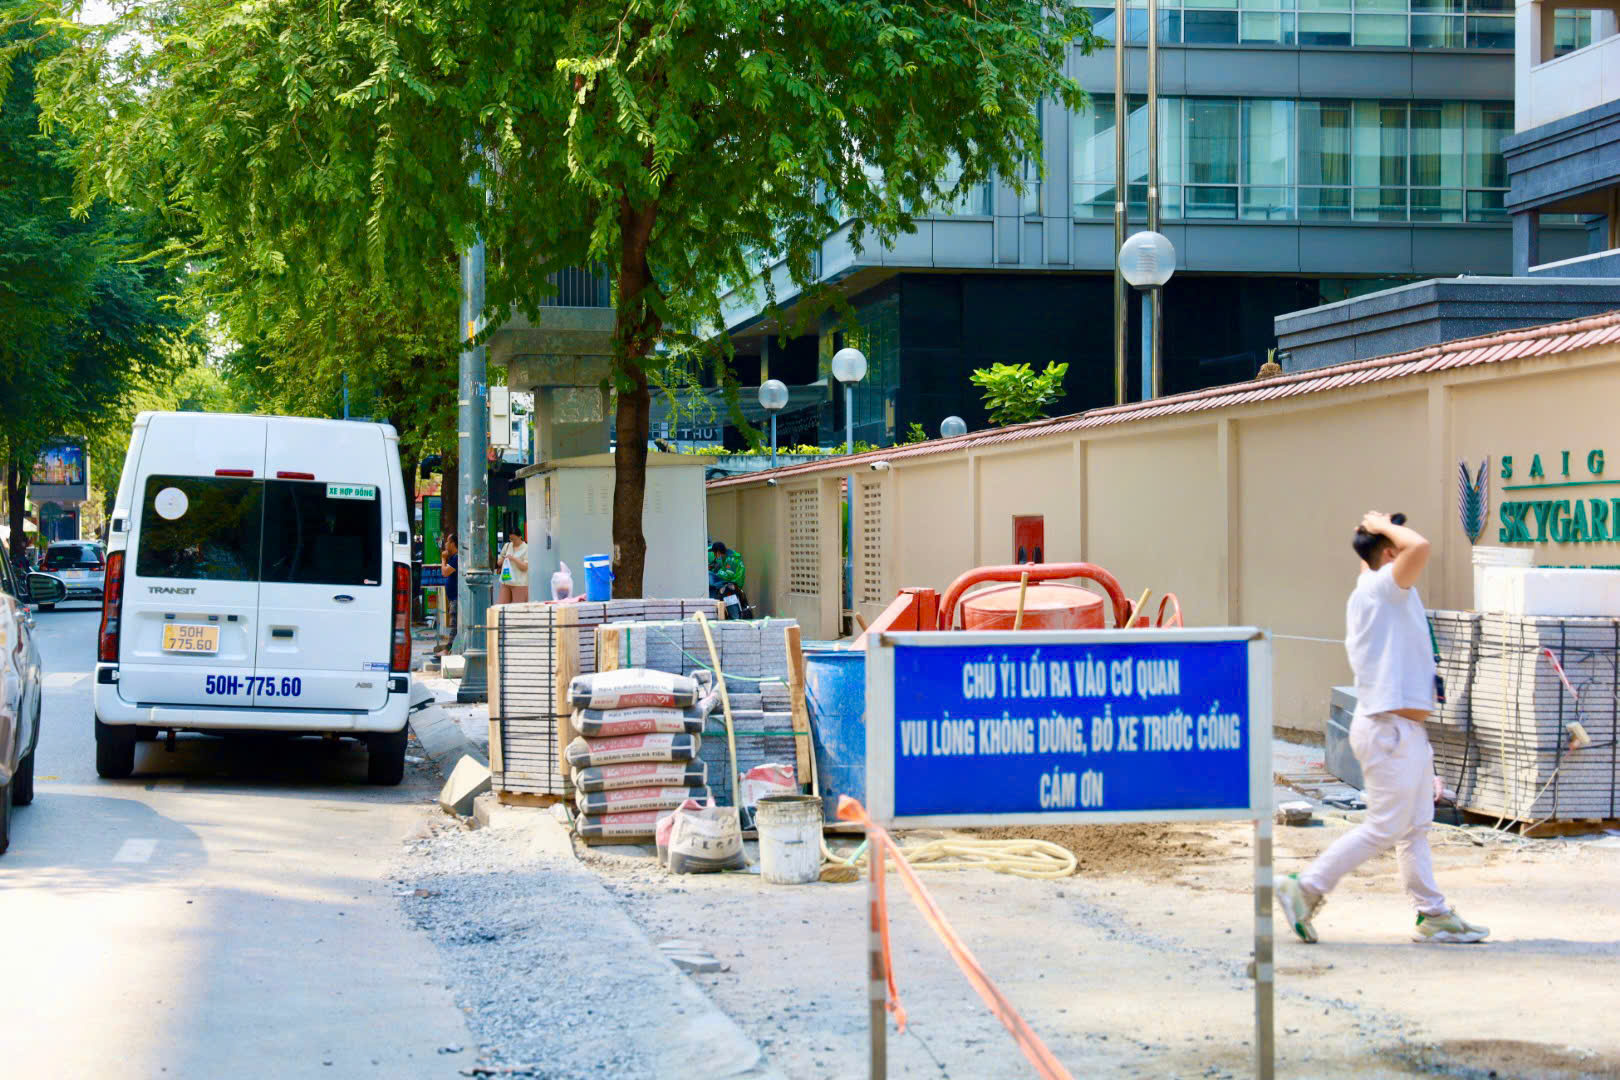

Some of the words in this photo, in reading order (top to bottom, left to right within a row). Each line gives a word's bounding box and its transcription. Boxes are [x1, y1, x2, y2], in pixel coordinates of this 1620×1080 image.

[329, 487, 338, 496] XE
[148, 586, 197, 595] TRANSIT
[179, 626, 205, 638] 50H
[169, 638, 213, 651] 775.60
[962, 653, 996, 699] CHÚ
[1020, 647, 1047, 698] LỐI
[1049, 660, 1072, 698] RA
[1074, 652, 1107, 698] VÀO
[1110, 656, 1133, 697] CƠ
[1136, 658, 1181, 701] QUAN
[205, 674, 302, 697] 50H-775.60
[900, 719, 928, 757] VUI
[931, 709, 975, 756] LÒNG
[978, 710, 1035, 756] KHÔNG
[1038, 709, 1088, 757] DỪNG,
[1116, 715, 1139, 752] XE
[1142, 706, 1194, 752] TRƯỚC
[1080, 767, 1104, 808] ƠN
